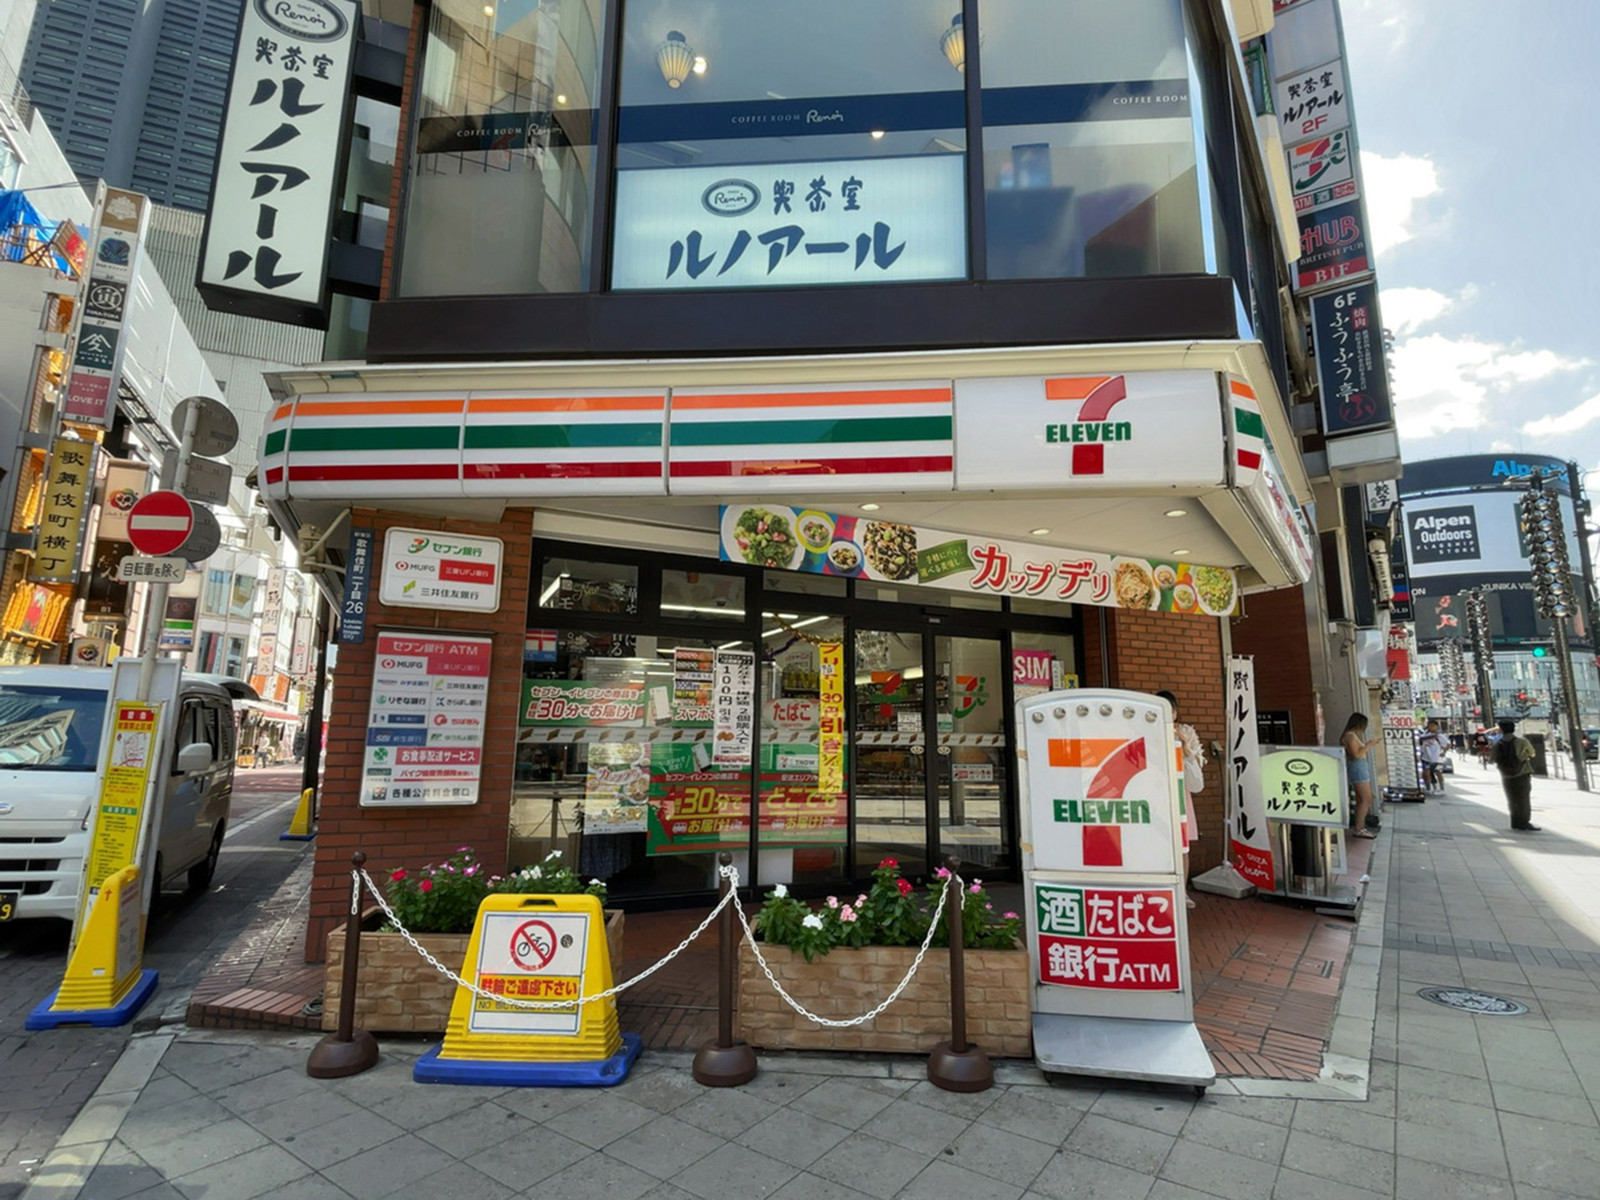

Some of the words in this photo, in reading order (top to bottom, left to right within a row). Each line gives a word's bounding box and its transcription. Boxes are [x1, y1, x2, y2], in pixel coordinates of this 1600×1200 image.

[275, 1, 326, 29] Renoir
[255, 36, 334, 80] 喫茶室
[1288, 71, 1333, 101] 喫茶室
[1113, 96, 1151, 104] COFFEE
[1156, 95, 1188, 103] ROOM
[1283, 90, 1343, 124] ルノアール
[731, 115, 767, 123] COFFEE
[771, 114, 801, 122] ROOM
[806, 109, 844, 123] Renoir
[1302, 114, 1328, 135] 2F
[494, 127, 522, 136] ROOM
[223, 77, 325, 290] ルノアール
[773, 174, 863, 216] 喫茶室
[1293, 194, 1313, 211] ATM
[1299, 215, 1360, 255] HUB
[665, 220, 907, 281] ルノアール
[1299, 248, 1341, 266] BRITISH
[1343, 242, 1364, 254] PUB
[1315, 262, 1351, 283] B1F
[1333, 291, 1357, 309] 6F
[1329, 312, 1359, 404] ふうふう亭
[68, 394, 93, 405] LOVE
[40, 450, 85, 571] 歌舞伎町横丁
[1413, 514, 1471, 531] Alpen
[1416, 540, 1475, 551] FLAGSHIP
[1420, 530, 1473, 543] Outdoors
[432, 543, 483, 558] セブン銀行
[1438, 547, 1476, 556] STORE
[123, 562, 180, 578] 自転車を除く
[351, 538, 368, 600] 歌舞伎町一丁目
[410, 563, 435, 573] MUFG
[973, 546, 1108, 600] カップデリ
[421, 586, 480, 601] 三井住友銀行
[345, 600, 364, 615] 26
[393, 641, 445, 655] セブン銀行
[448, 645, 479, 656] ATM
[396, 661, 424, 669] MUFG
[1013, 655, 1050, 681] SIM
[388, 696, 427, 706] りそな銀行
[773, 702, 811, 721] たばこ
[375, 734, 392, 743] SBI
[1384, 729, 1412, 739] DVD
[401, 750, 476, 763] お食事配達サービス
[1232, 694, 1257, 841] ルノアール
[1282, 780, 1320, 797] 喫茶室
[1047, 737, 1147, 867] 7
[1267, 797, 1337, 815] ルノアール
[1039, 889, 1081, 933] 酒
[1087, 893, 1172, 936] たばこ
